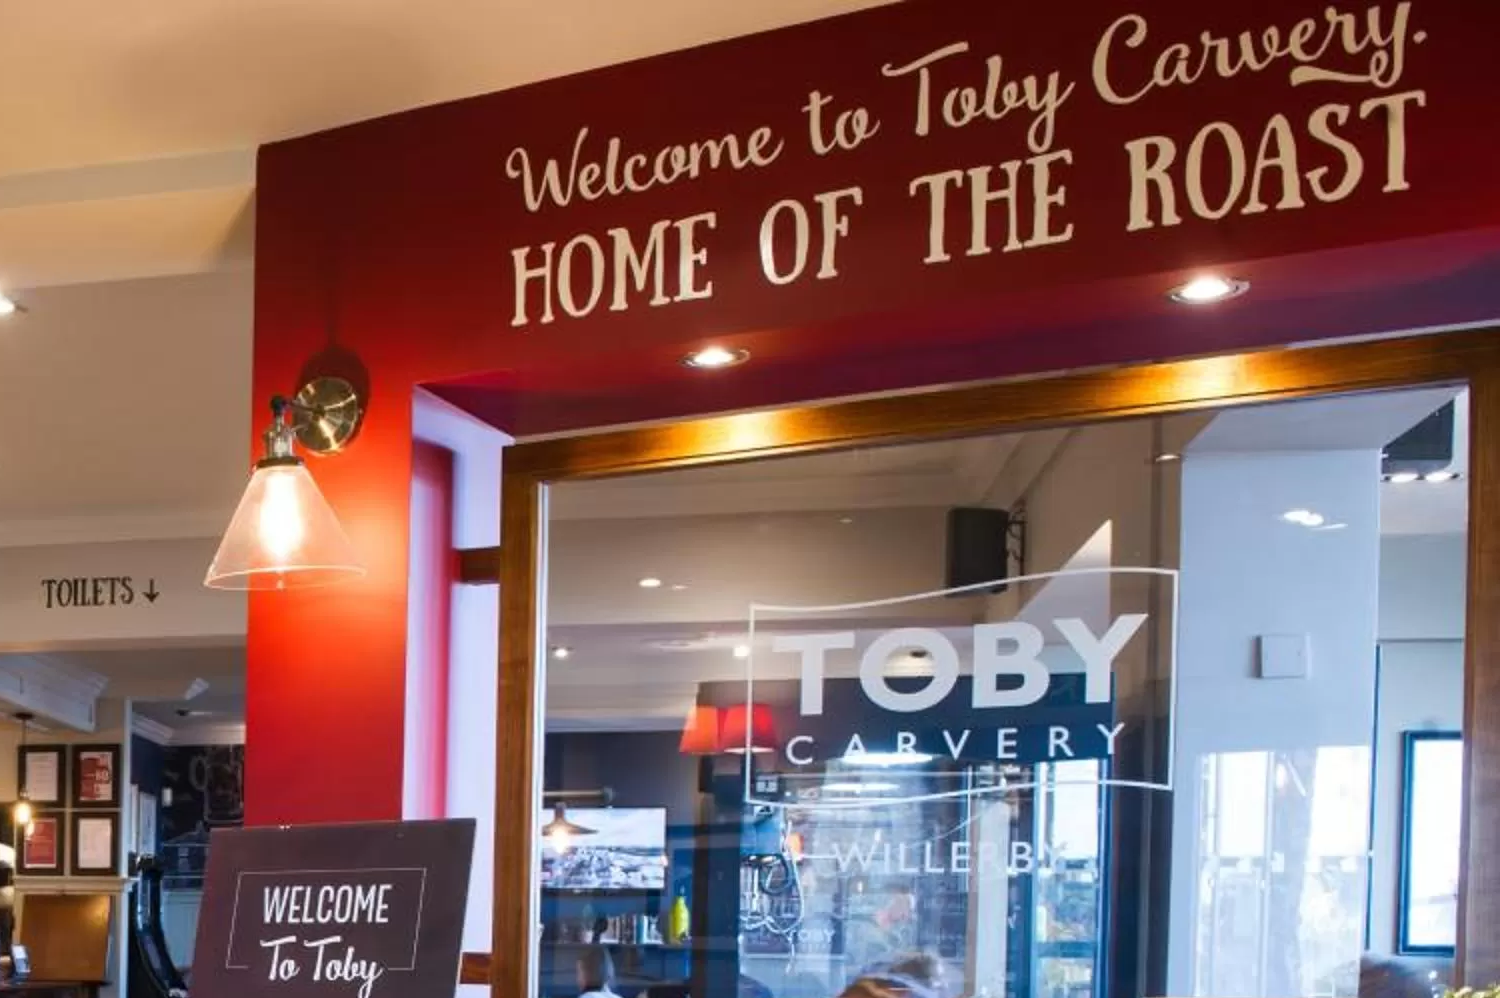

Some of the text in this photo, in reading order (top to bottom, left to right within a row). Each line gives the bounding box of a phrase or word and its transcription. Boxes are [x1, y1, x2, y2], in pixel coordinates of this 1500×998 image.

[505, 127, 784, 213] Welcome
[802, 90, 880, 155] to
[882, 41, 1075, 153] Toby
[511, 91, 1427, 327] HOME OF THE ROAST
[41, 576, 134, 608] TOILETS
[773, 613, 1149, 716] TOBY
[786, 722, 1124, 765] CARVERY
[832, 840, 1068, 877] WILLERBY
[263, 884, 393, 924] WELCOME
[260, 935, 300, 981] To
